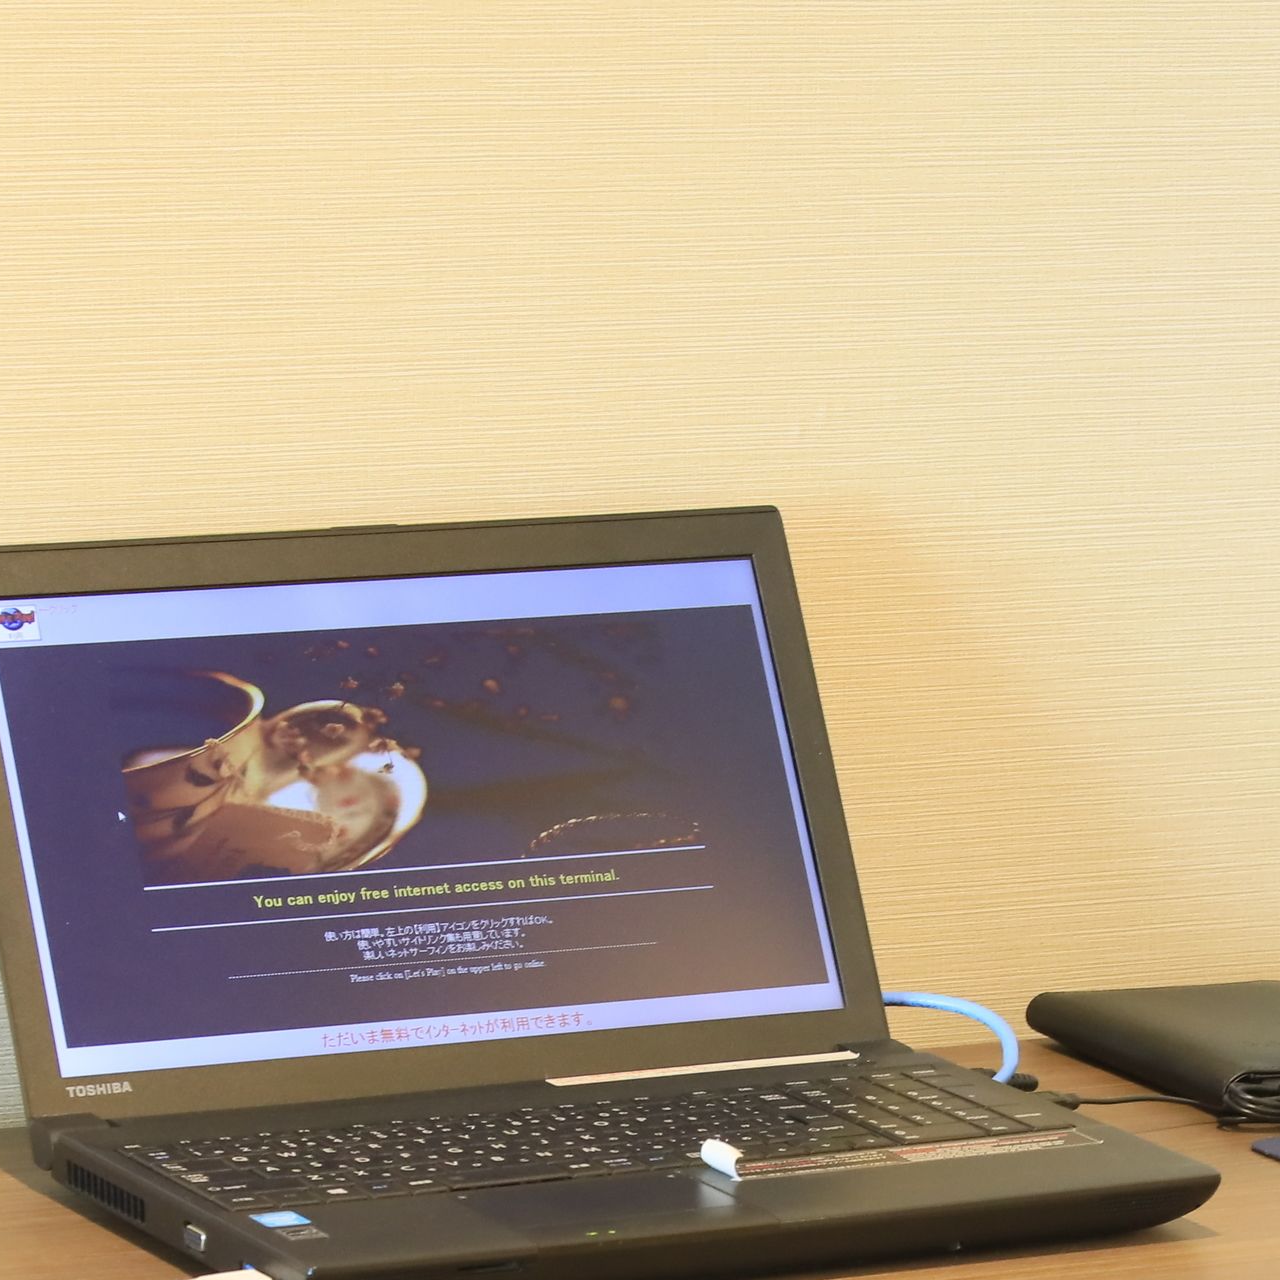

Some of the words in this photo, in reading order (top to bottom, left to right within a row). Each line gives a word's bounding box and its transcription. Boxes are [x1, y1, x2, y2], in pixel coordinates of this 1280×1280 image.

[253, 895, 282, 909] You
[287, 895, 313, 906] can
[317, 890, 356, 905] enjoy
[360, 887, 389, 900] free
[393, 883, 451, 898] internet
[455, 880, 504, 892] access
[508, 878, 525, 889] on
[529, 874, 556, 887] this
[559, 869, 620, 885] terminal.
[65, 1081, 133, 1098] TOSHIBA
